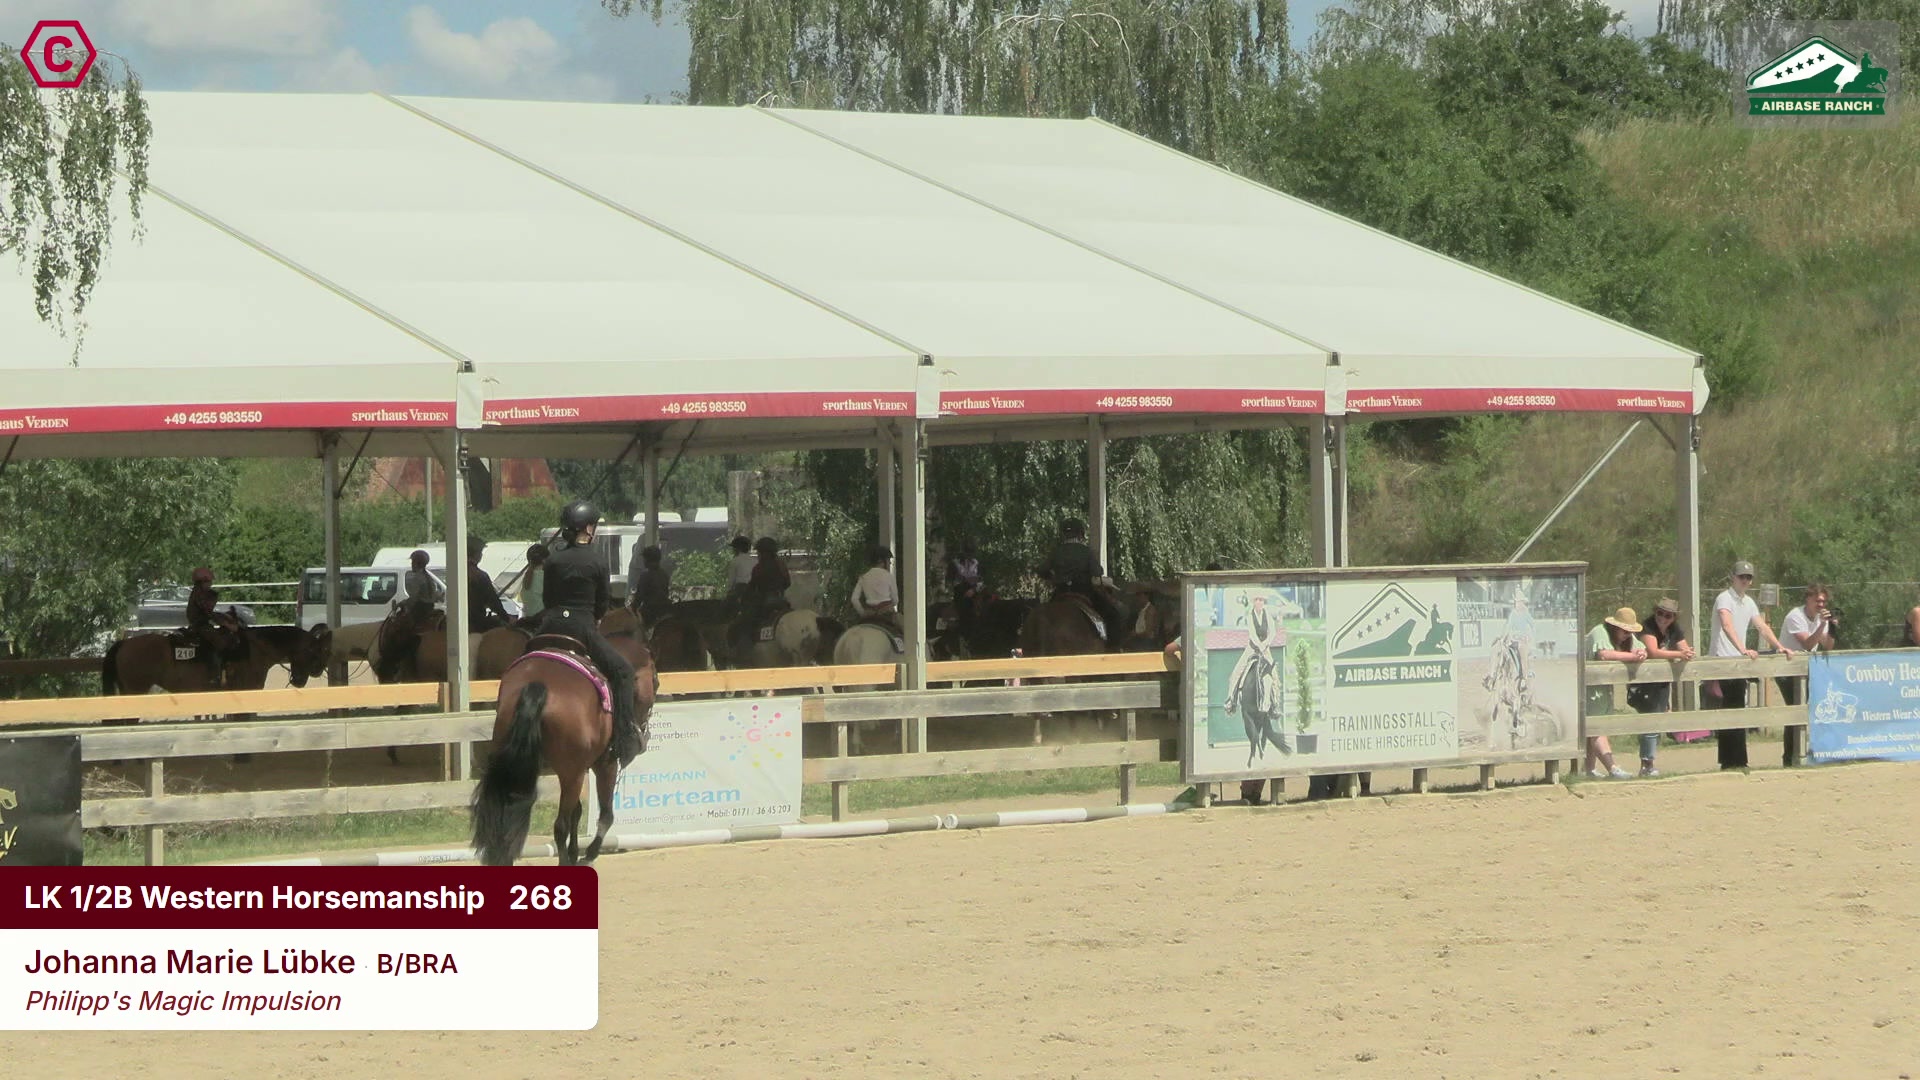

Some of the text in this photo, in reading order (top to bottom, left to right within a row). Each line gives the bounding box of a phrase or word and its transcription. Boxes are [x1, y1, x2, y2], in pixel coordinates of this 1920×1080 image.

[660, 401, 747, 414] +49 4255 983550
[823, 399, 872, 411] sporthaus
[942, 398, 990, 410] sporthaus
[1096, 396, 1173, 408] +49 4255 983550
[1242, 397, 1285, 408] sporthaus
[1348, 396, 1391, 408] sporthaus
[1487, 396, 1556, 406] +49 4255 983550
[1617, 397, 1657, 408] sporthaus
[164, 411, 262, 425] +49 4255 983550
[352, 409, 408, 422] sporthaus
[486, 406, 541, 420] sporthaus
[1345, 665, 1442, 682] AIRBASE RANCH
[1846, 664, 1896, 686] Cowboy
[1331, 712, 1437, 732] TRAININGSSTALL
[1331, 733, 1437, 752] ETIENNE HIRSCHFELD
